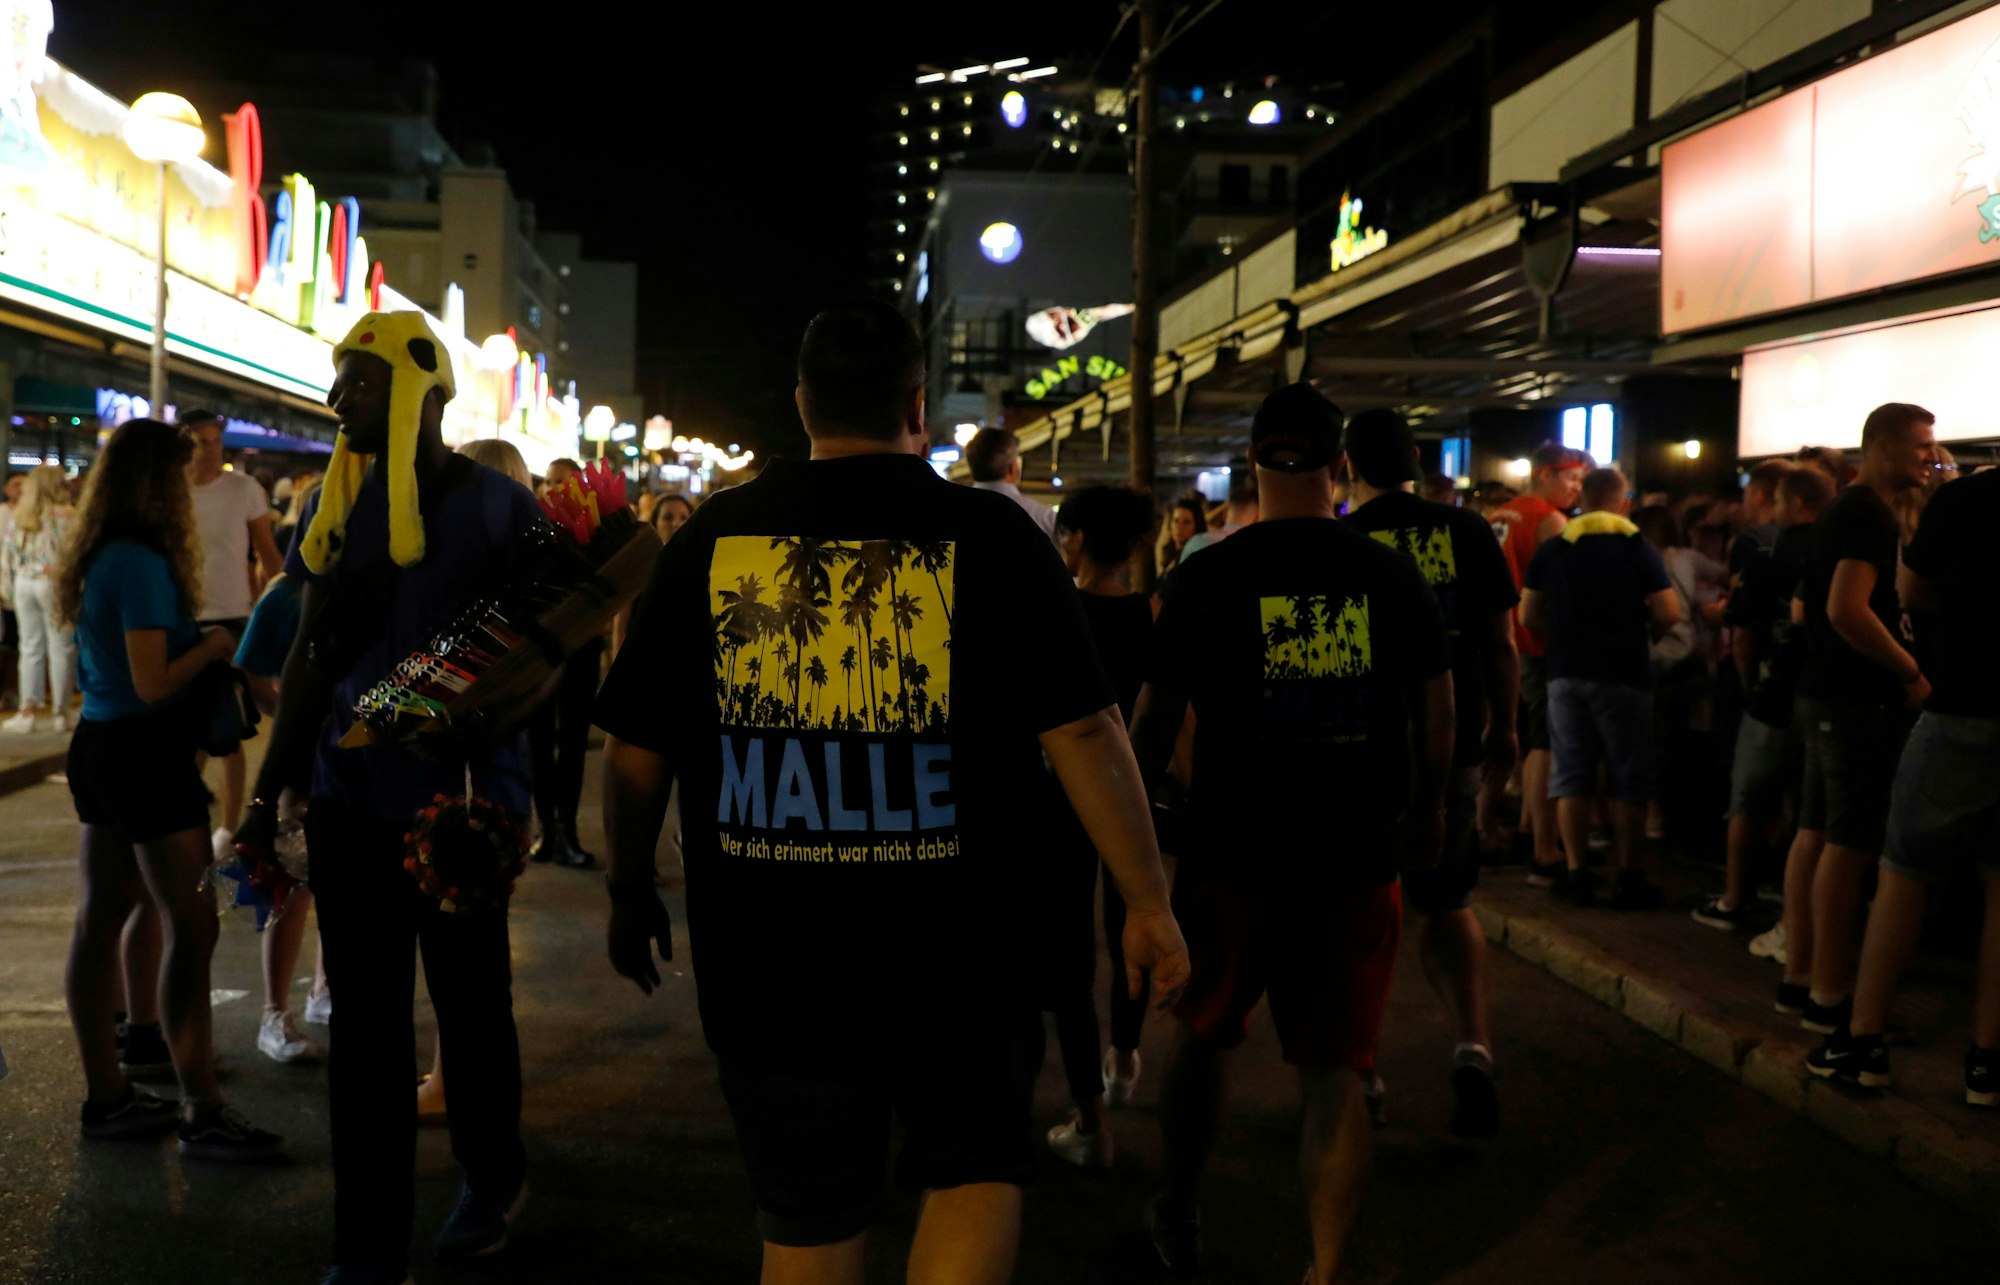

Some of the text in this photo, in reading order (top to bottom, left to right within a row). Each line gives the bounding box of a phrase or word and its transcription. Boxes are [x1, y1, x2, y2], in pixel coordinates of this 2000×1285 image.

[1025, 354, 1127, 400] SAN SI
[717, 734, 956, 832] MALLE
[719, 831, 960, 862] Wer sich erinnert war nicht dabei
